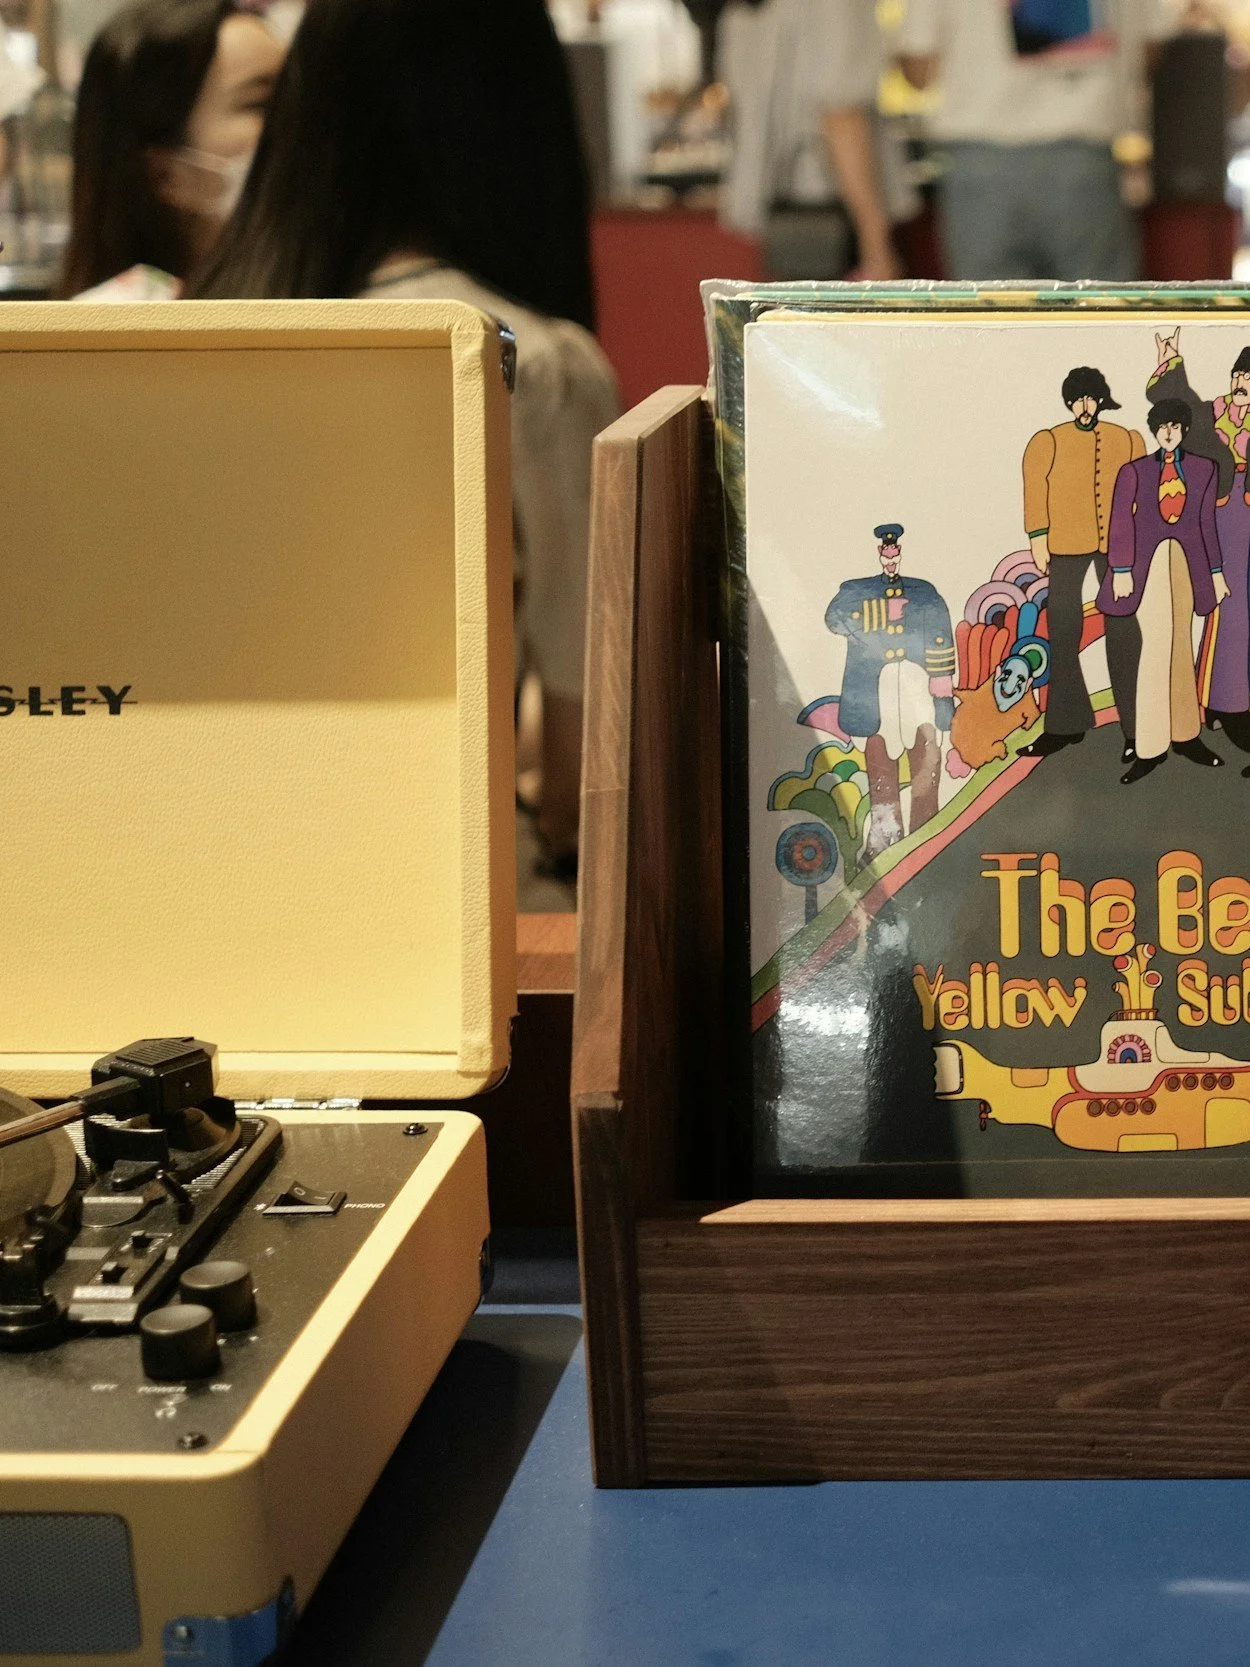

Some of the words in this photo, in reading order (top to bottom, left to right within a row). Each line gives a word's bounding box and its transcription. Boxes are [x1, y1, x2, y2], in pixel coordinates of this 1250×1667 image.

[980, 851, 1136, 958] The
[912, 961, 1088, 1031] Yellow
[209, 1383, 233, 1392] ON
